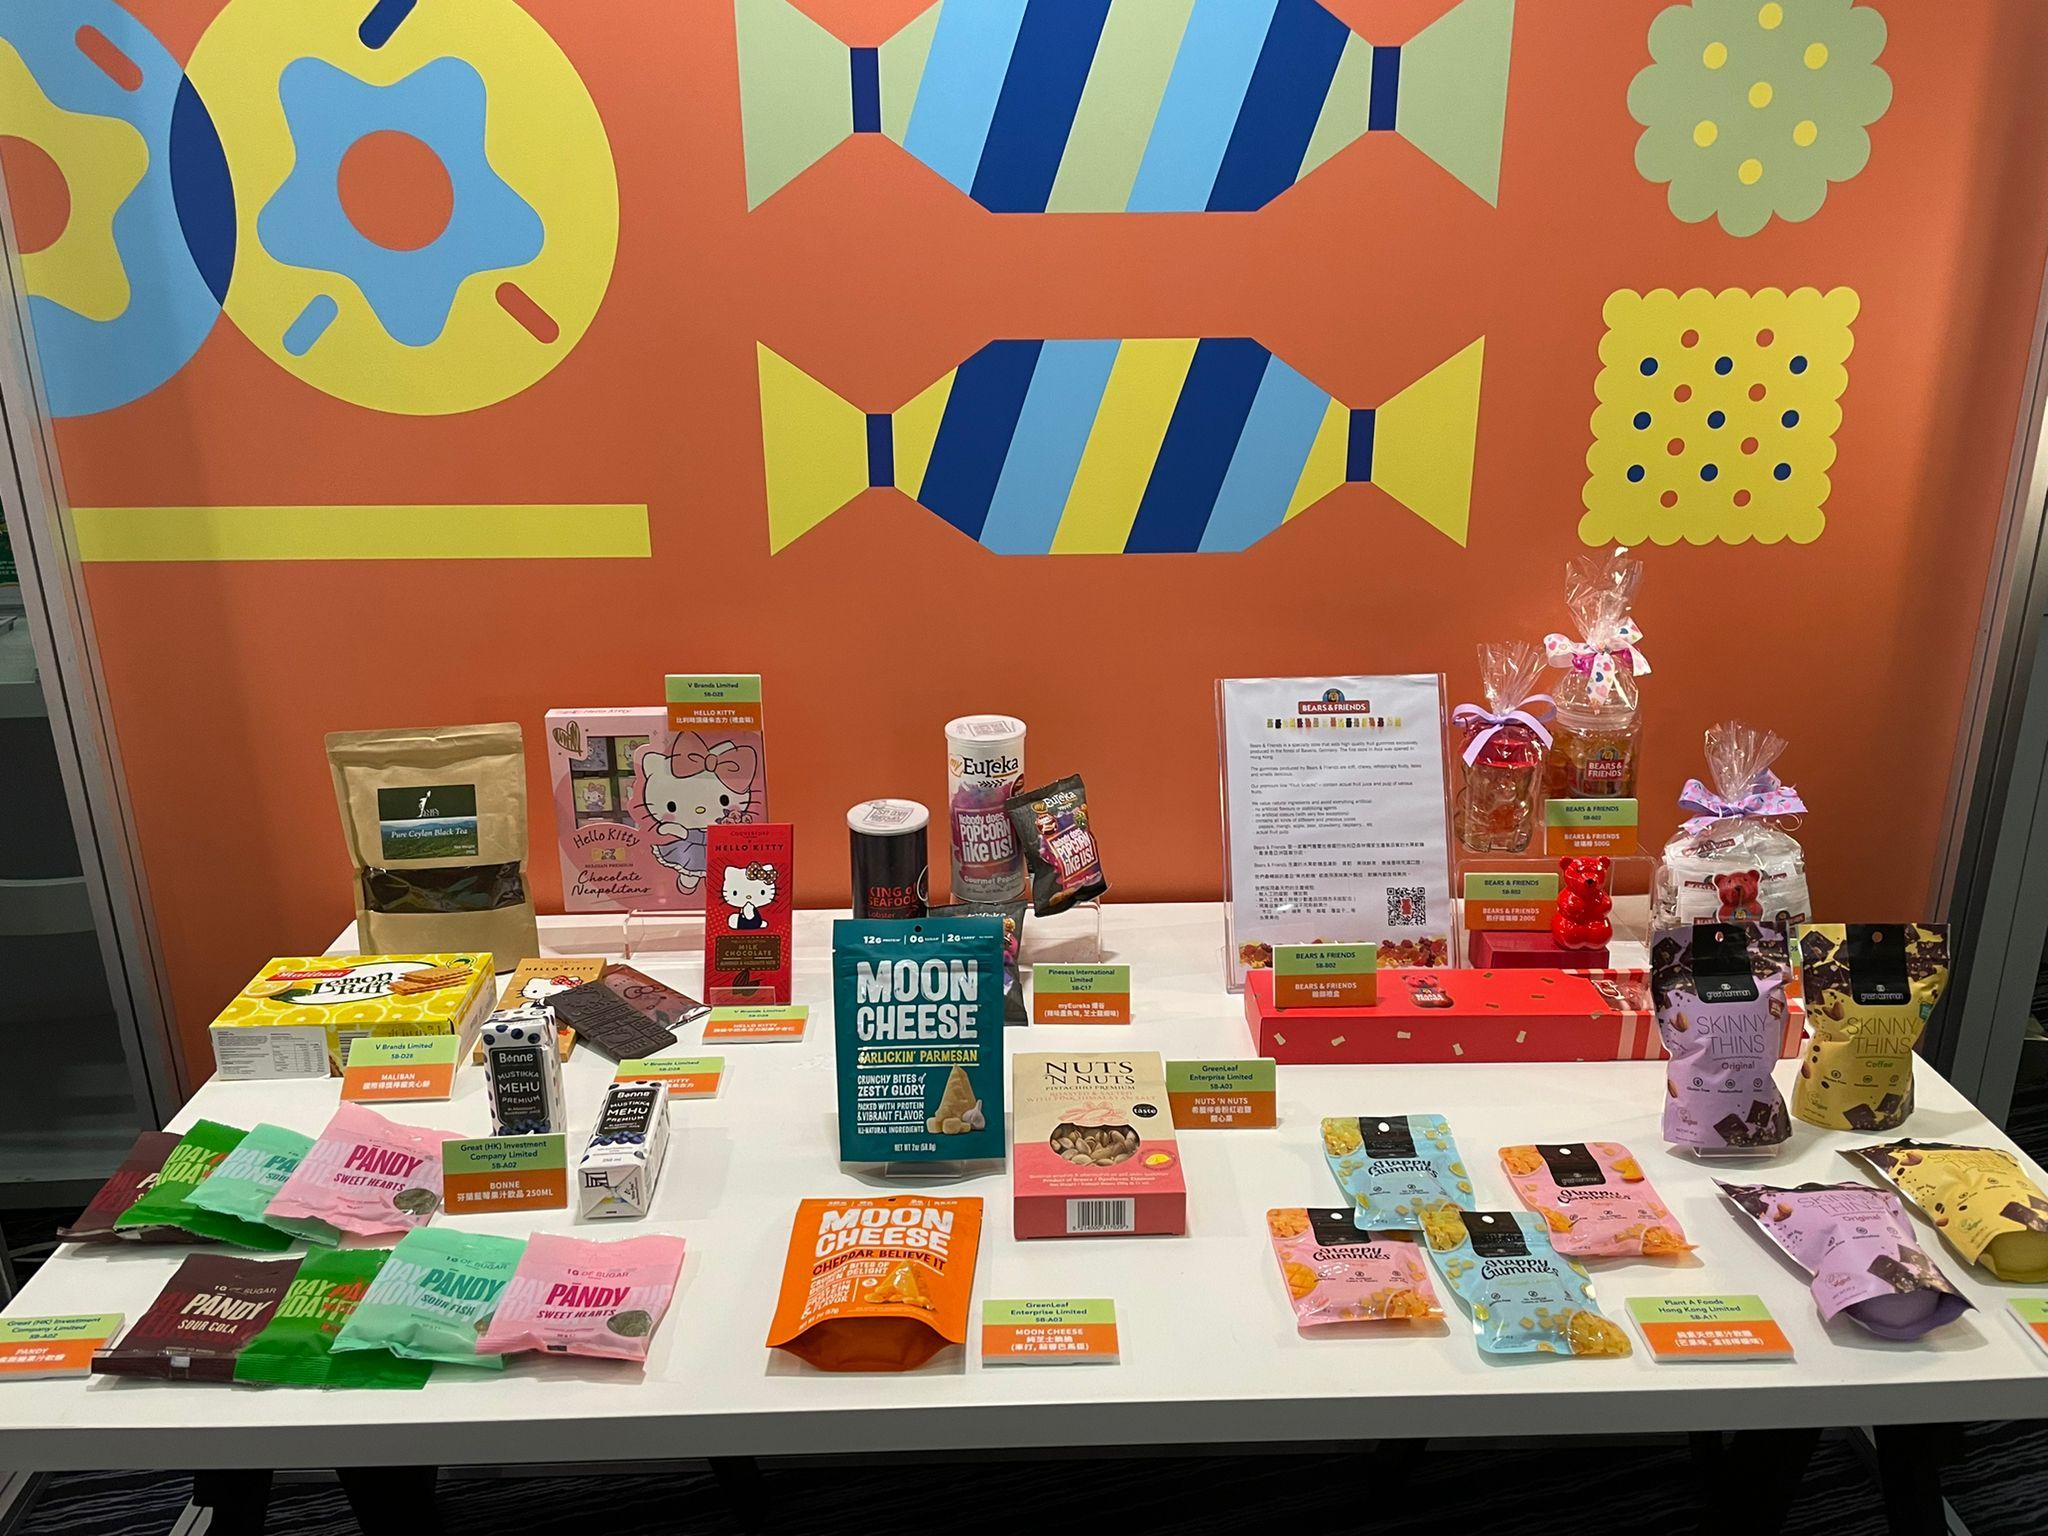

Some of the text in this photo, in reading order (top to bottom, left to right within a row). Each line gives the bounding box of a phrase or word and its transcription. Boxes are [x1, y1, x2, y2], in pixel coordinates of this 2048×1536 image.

[963, 756, 1019, 777] Eureka
[1588, 769, 1622, 777] FRIENDS
[986, 812, 1005, 823] does
[391, 827, 468, 839] Pure Ceylon Black Tea
[960, 819, 1011, 842] POPCORN
[573, 828, 640, 849] Hello Kitty
[715, 844, 749, 852] HELLO
[962, 835, 1014, 862] like us!
[1056, 832, 1091, 860] POPCORN
[577, 870, 642, 884] Chocolate
[571, 884, 651, 898] Neapolitans
[856, 958, 978, 1004] MOON
[857, 1003, 979, 1041] CHEESE
[1696, 1014, 1767, 1035] SKINNY
[1847, 1016, 1920, 1035] SKINNY
[1708, 1034, 1765, 1055] THINS
[1854, 1036, 1912, 1055] THINS
[499, 1052, 533, 1064] Bonne
[919, 1049, 978, 1062] PARMESAN
[1046, 1061, 1134, 1074] NUTS
[1721, 1061, 1755, 1071] Original
[1865, 1060, 1894, 1069] Coffee
[497, 1070, 539, 1081] MUSTIKKA
[857, 1074, 917, 1085] CRUNCHY BITES
[1076, 1074, 1135, 1085] NUTS
[1189, 1074, 1225, 1082] Enterprise
[499, 1081, 540, 1094] MEHU
[858, 1084, 926, 1097] ZESTY GLORY
[502, 1095, 541, 1104] PREMIUM
[877, 1102, 895, 1110] WITH
[896, 1101, 925, 1110] PROTEIN
[607, 1107, 649, 1116] MEHU
[894, 1110, 924, 1121] FLAVOR
[888, 1125, 924, 1134] INGREDIENTS
[460, 1140, 547, 1152] Great (HK) Investment
[470, 1150, 538, 1161] Company Limited
[1374, 1160, 1432, 1168] Happy
[1368, 1165, 1439, 1179] Gummies
[333, 1173, 406, 1192] SWEET HEARTS
[489, 1181, 520, 1190] BONNE
[525, 1188, 553, 1198] 250ML
[818, 1207, 954, 1236] MOON
[1842, 1214, 1881, 1222] Original
[815, 1226, 951, 1258] CHEESE
[1313, 1251, 1390, 1262] Gummies
[1319, 1247, 1382, 1255] Happy
[813, 1249, 946, 1276] CHEDDAR BELIEVE IT
[850, 1261, 879, 1269] BITES
[1485, 1257, 1549, 1268] Happy
[597, 1271, 629, 1279] SUGAR
[847, 1267, 888, 1277] DELIGHT
[1481, 1265, 1559, 1281] Gummies
[421, 1294, 476, 1317] SOUR FISH
[1658, 1307, 1683, 1315] Hong
[536, 1309, 616, 1320] SWEET HEARTS
[54, 1317, 101, 1325] Investment
[178, 1319, 238, 1334] SOUR COLA
